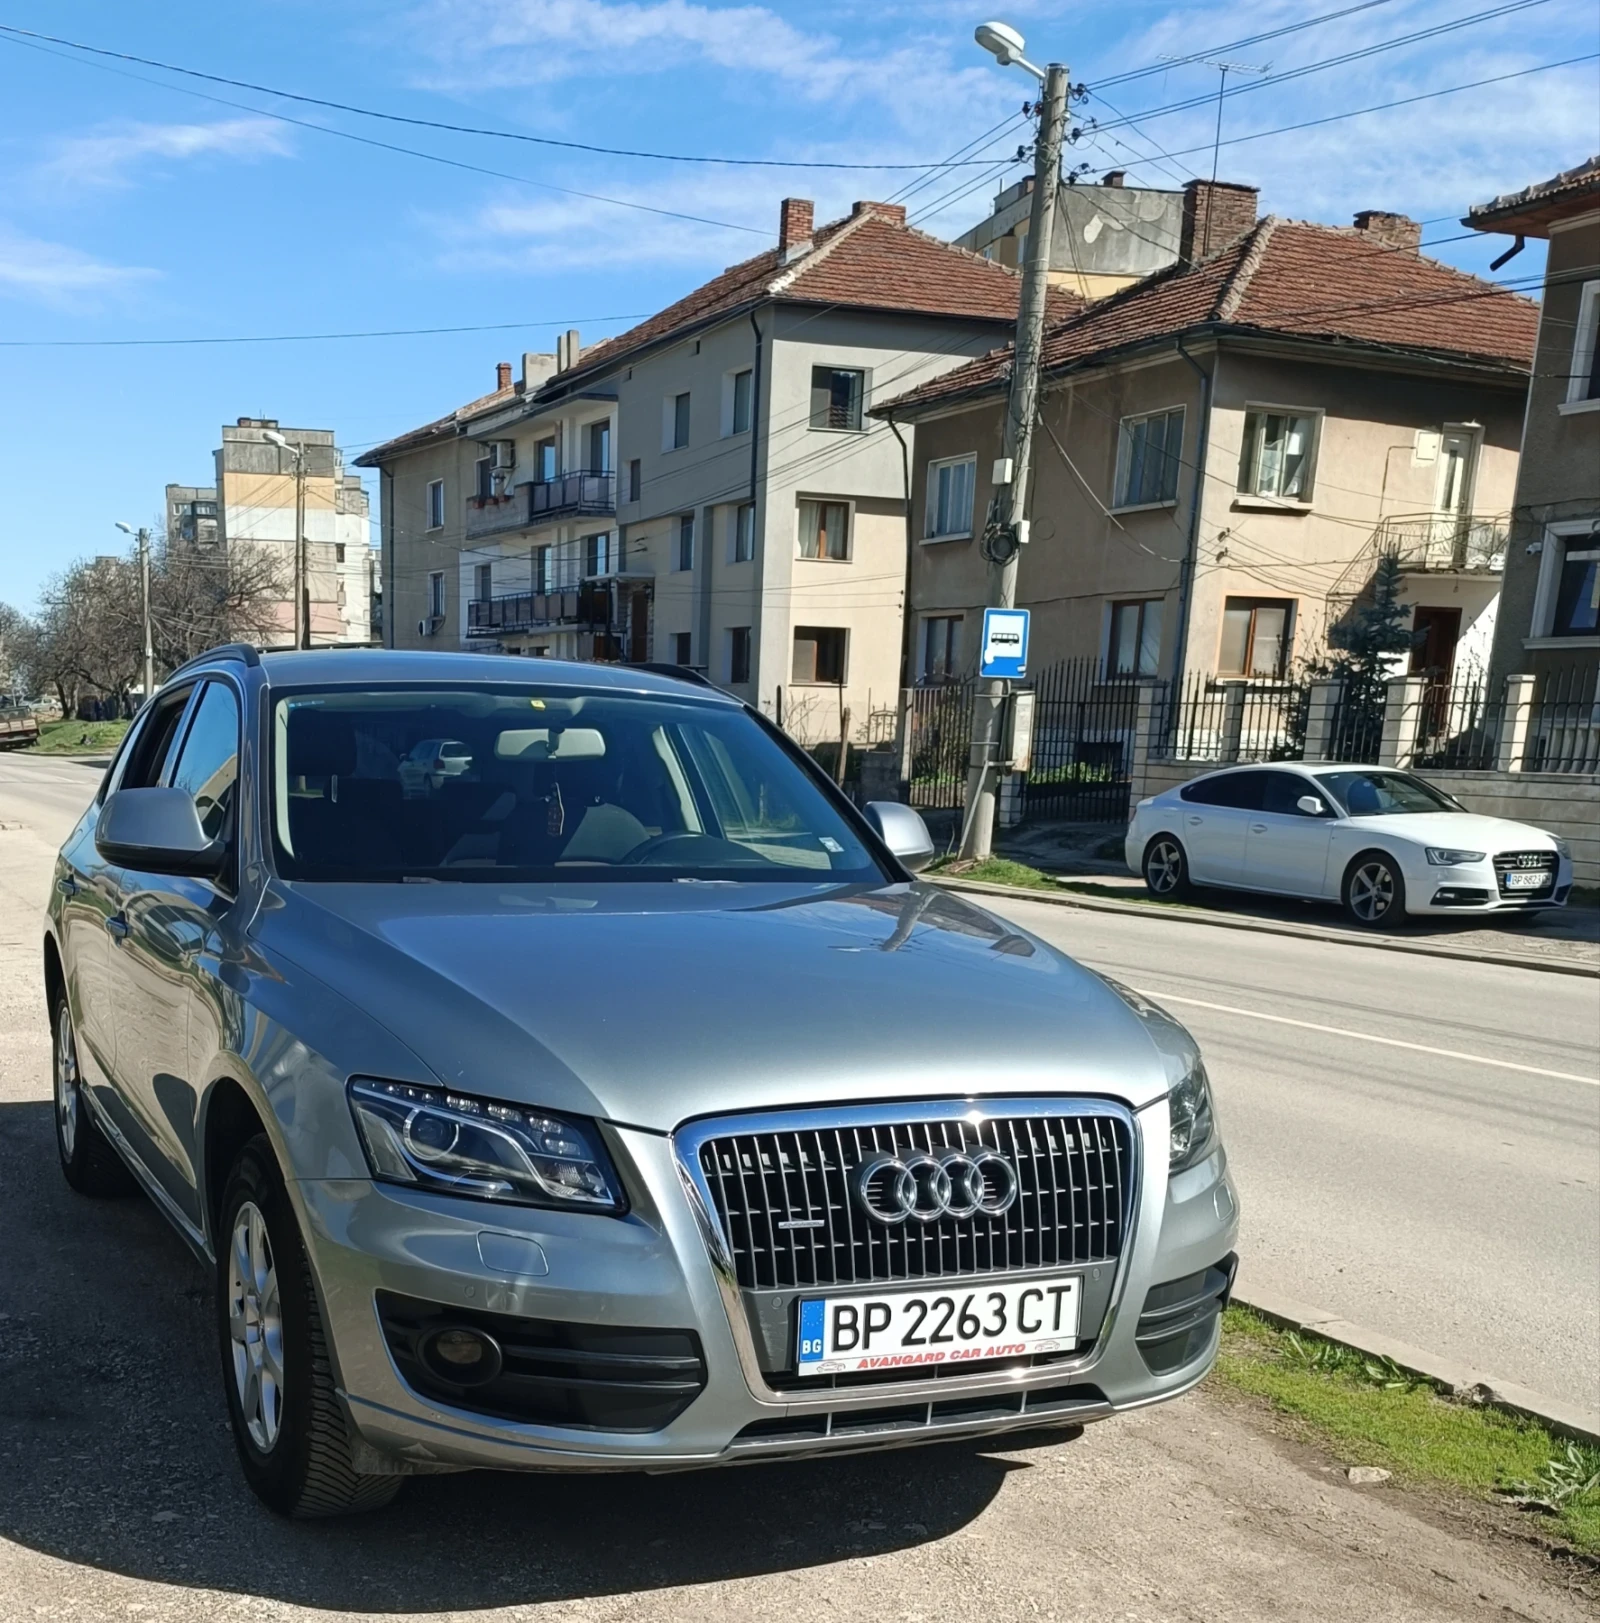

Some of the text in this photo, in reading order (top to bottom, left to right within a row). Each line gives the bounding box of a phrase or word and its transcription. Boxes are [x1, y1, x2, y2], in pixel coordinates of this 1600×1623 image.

[831, 1285, 1071, 1352] BP 2263 CT
[802, 1339, 821, 1354] BG
[857, 1343, 1026, 1369] AVANGARD CAR AUTO
